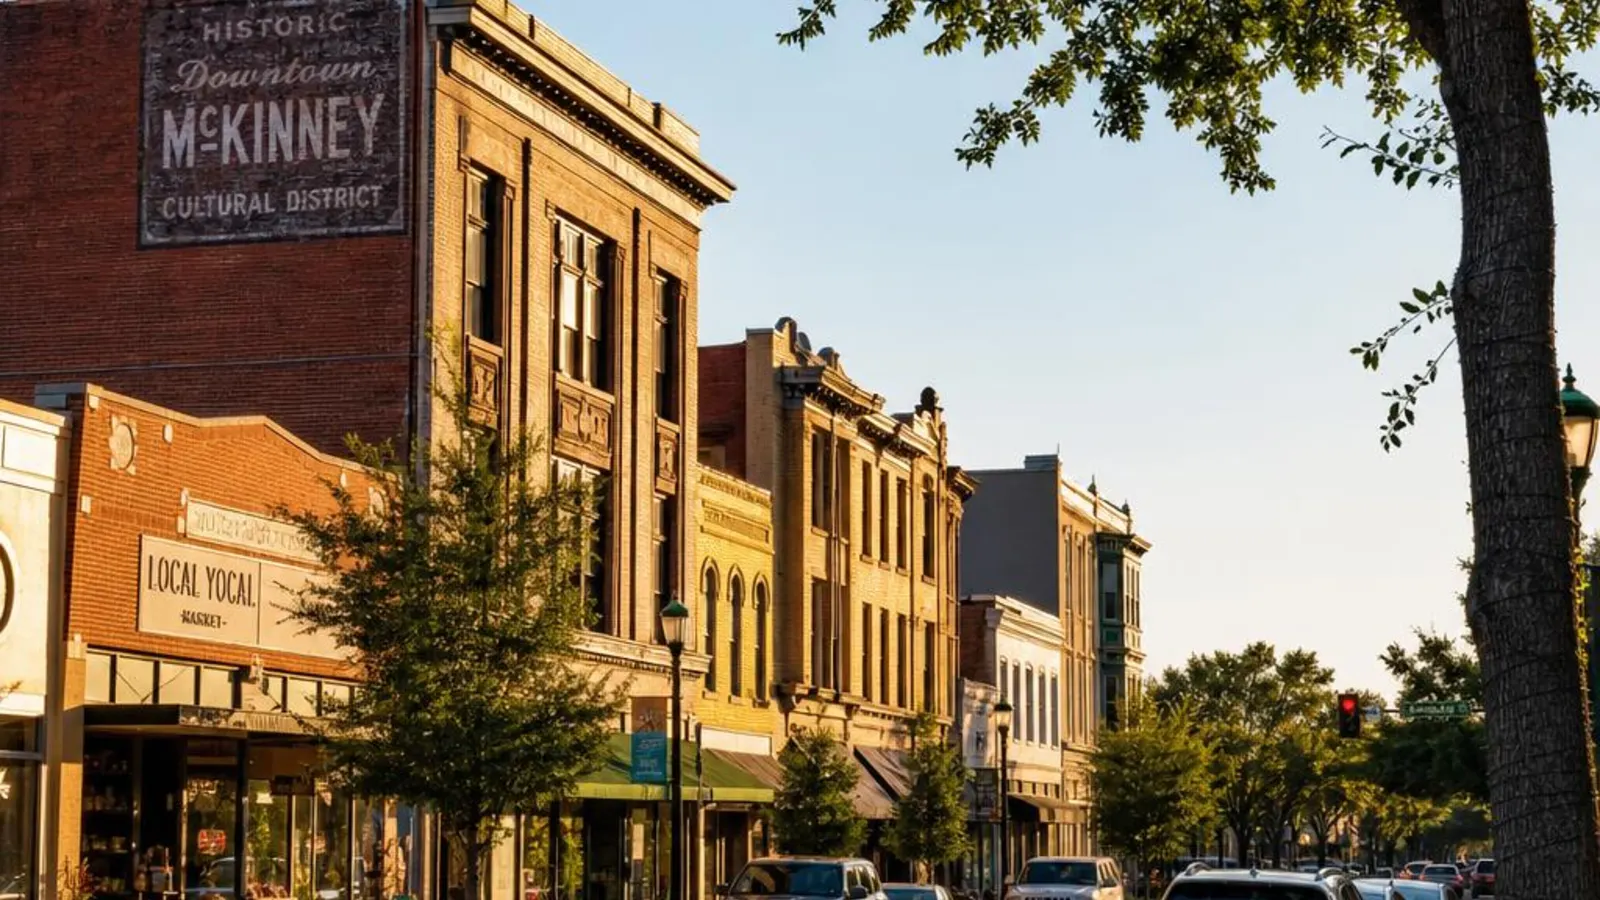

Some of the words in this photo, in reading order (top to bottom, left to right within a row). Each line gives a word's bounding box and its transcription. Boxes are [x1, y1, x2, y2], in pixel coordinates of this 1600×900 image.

[202, 12, 349, 41] HISTORIC
[170, 59, 376, 93] Downtown
[162, 192, 276, 220] CULTURAL
[286, 185, 382, 213] DISTRICT
[148, 555, 200, 598] LOCAL
[206, 565, 256, 607] YOCAL
